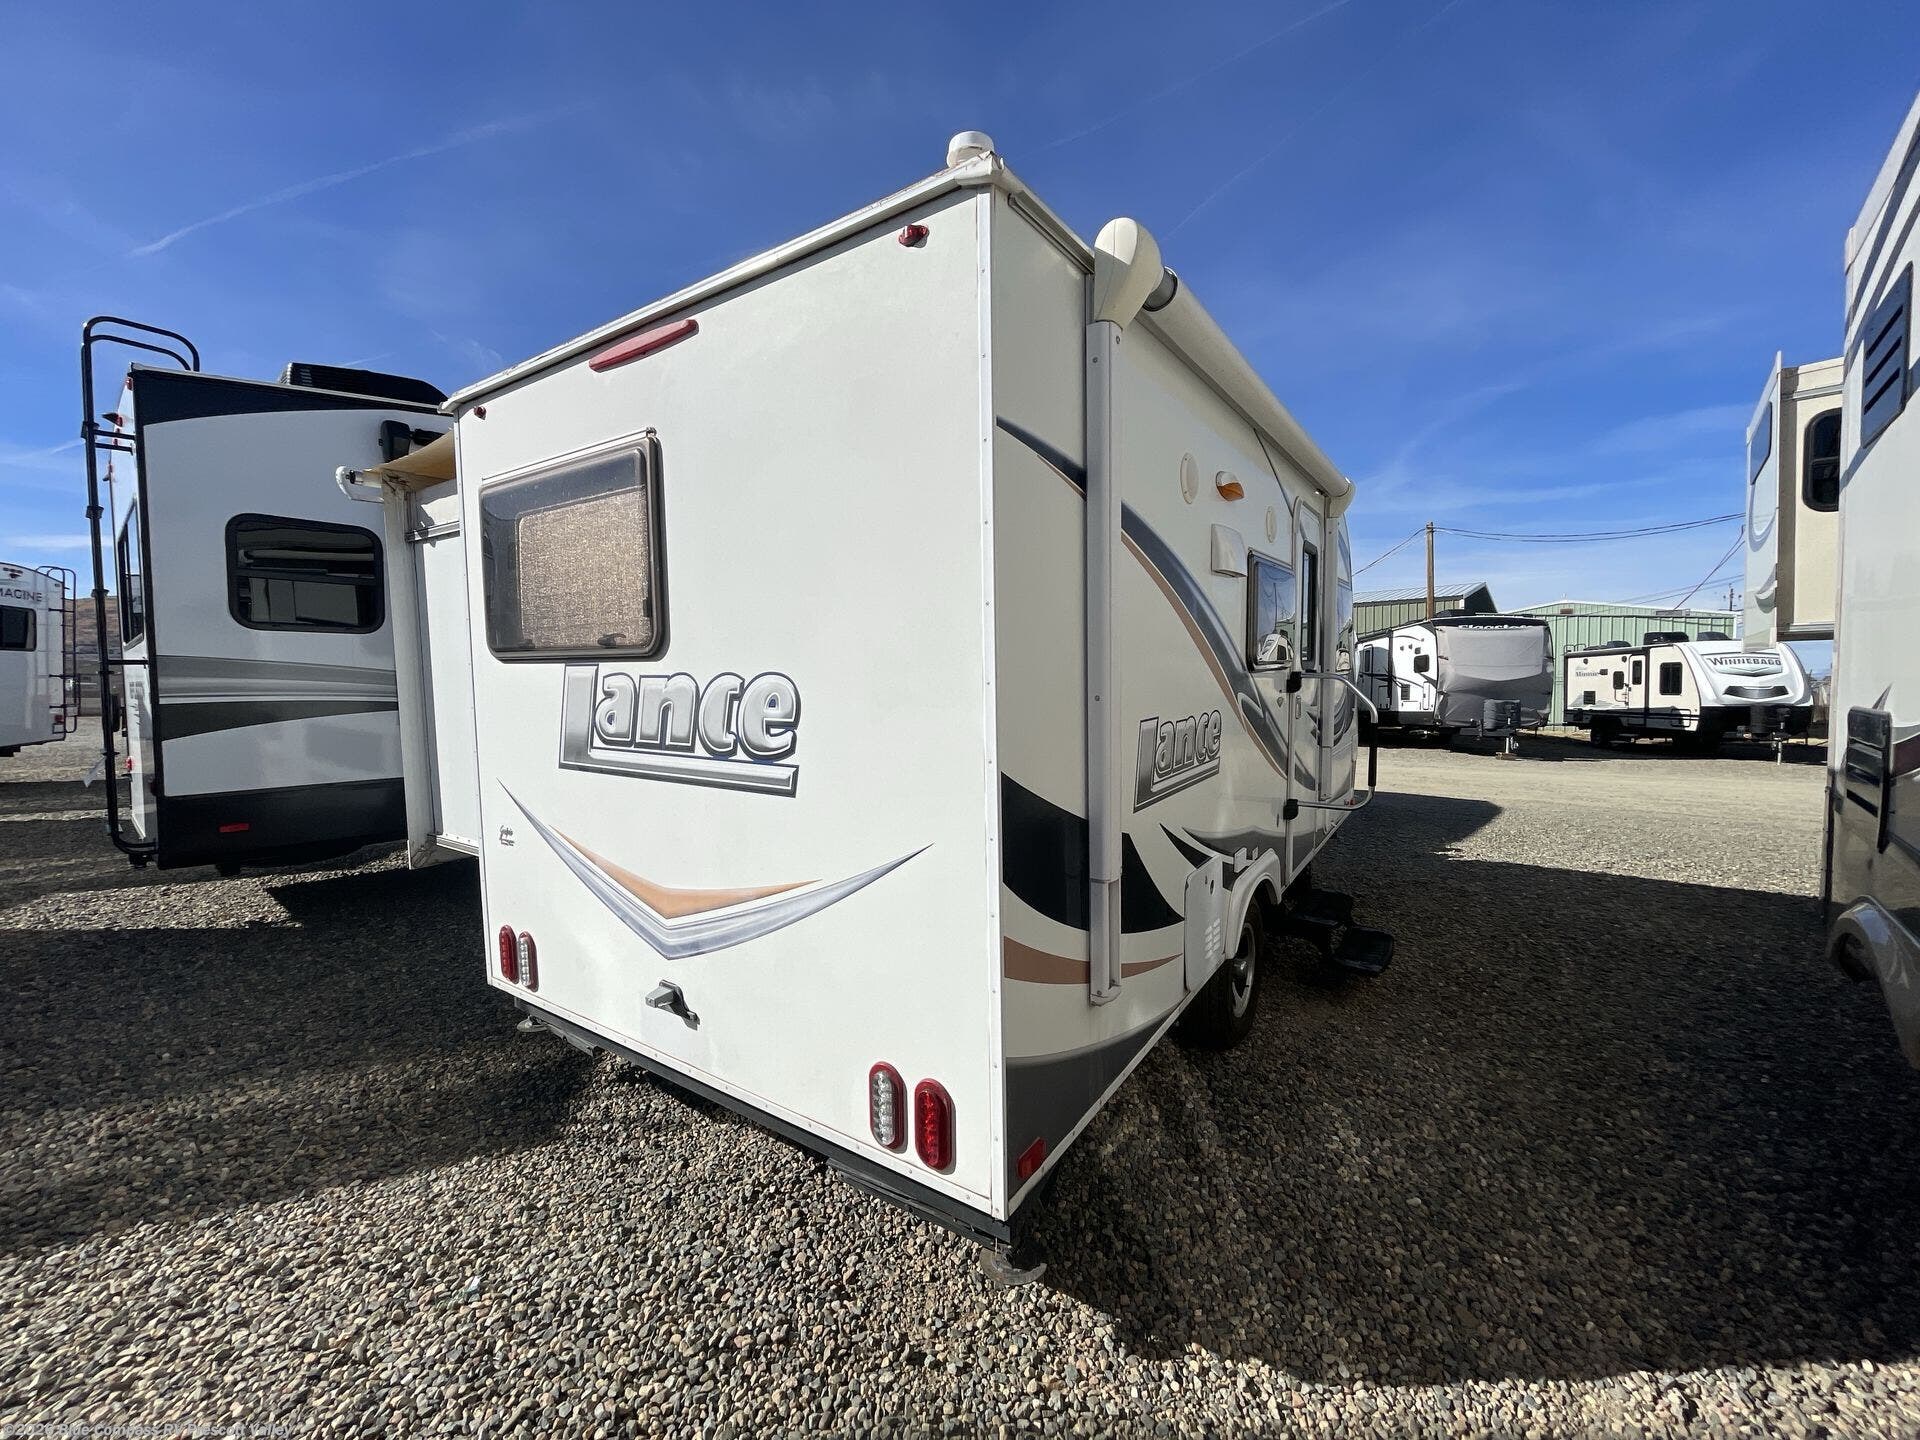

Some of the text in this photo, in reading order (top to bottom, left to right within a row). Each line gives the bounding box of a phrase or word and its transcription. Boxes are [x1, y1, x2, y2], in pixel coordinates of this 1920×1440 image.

[1706, 657, 1782, 666] WINNEBAGO
[558, 663, 801, 798] Lance
[1133, 709, 1222, 813] Lance
